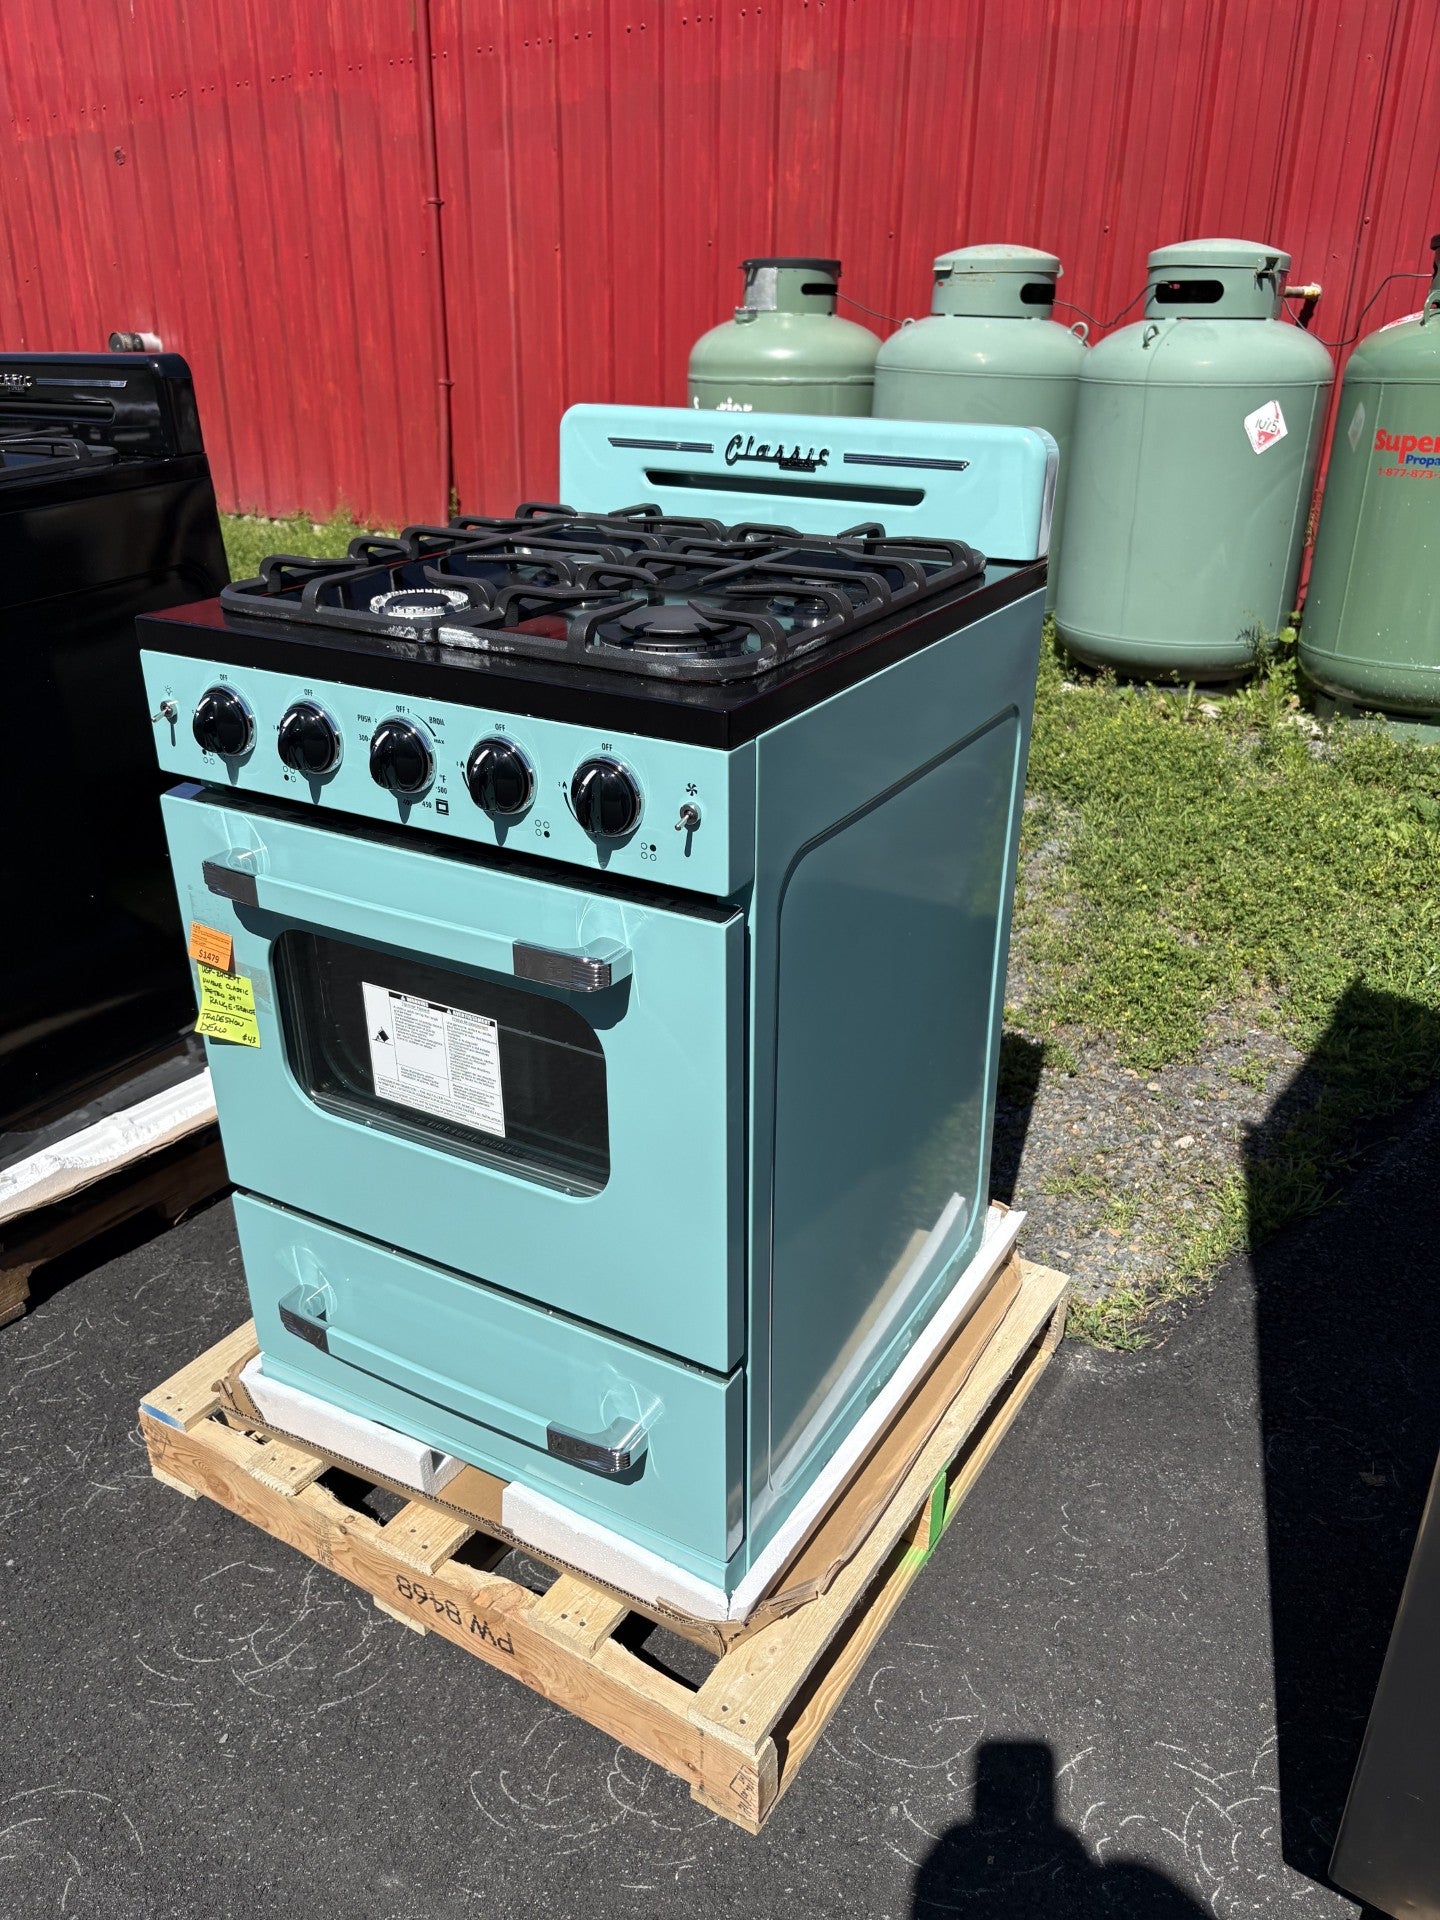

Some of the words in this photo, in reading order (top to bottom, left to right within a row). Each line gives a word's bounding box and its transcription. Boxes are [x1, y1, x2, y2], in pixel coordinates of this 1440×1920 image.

[725, 434, 830, 467] Classic
[304, 689, 313, 697] OFF
[396, 705, 406, 714] OFF
[357, 714, 372, 724] PUSH
[495, 723, 505, 731] OFF
[601, 743, 613, 751] OFF
[226, 983, 249, 995] CLASSIC
[202, 1012, 245, 1027] TRADESHOW
[396, 1574, 462, 1625] 8468
[470, 1614, 515, 1655] PW
